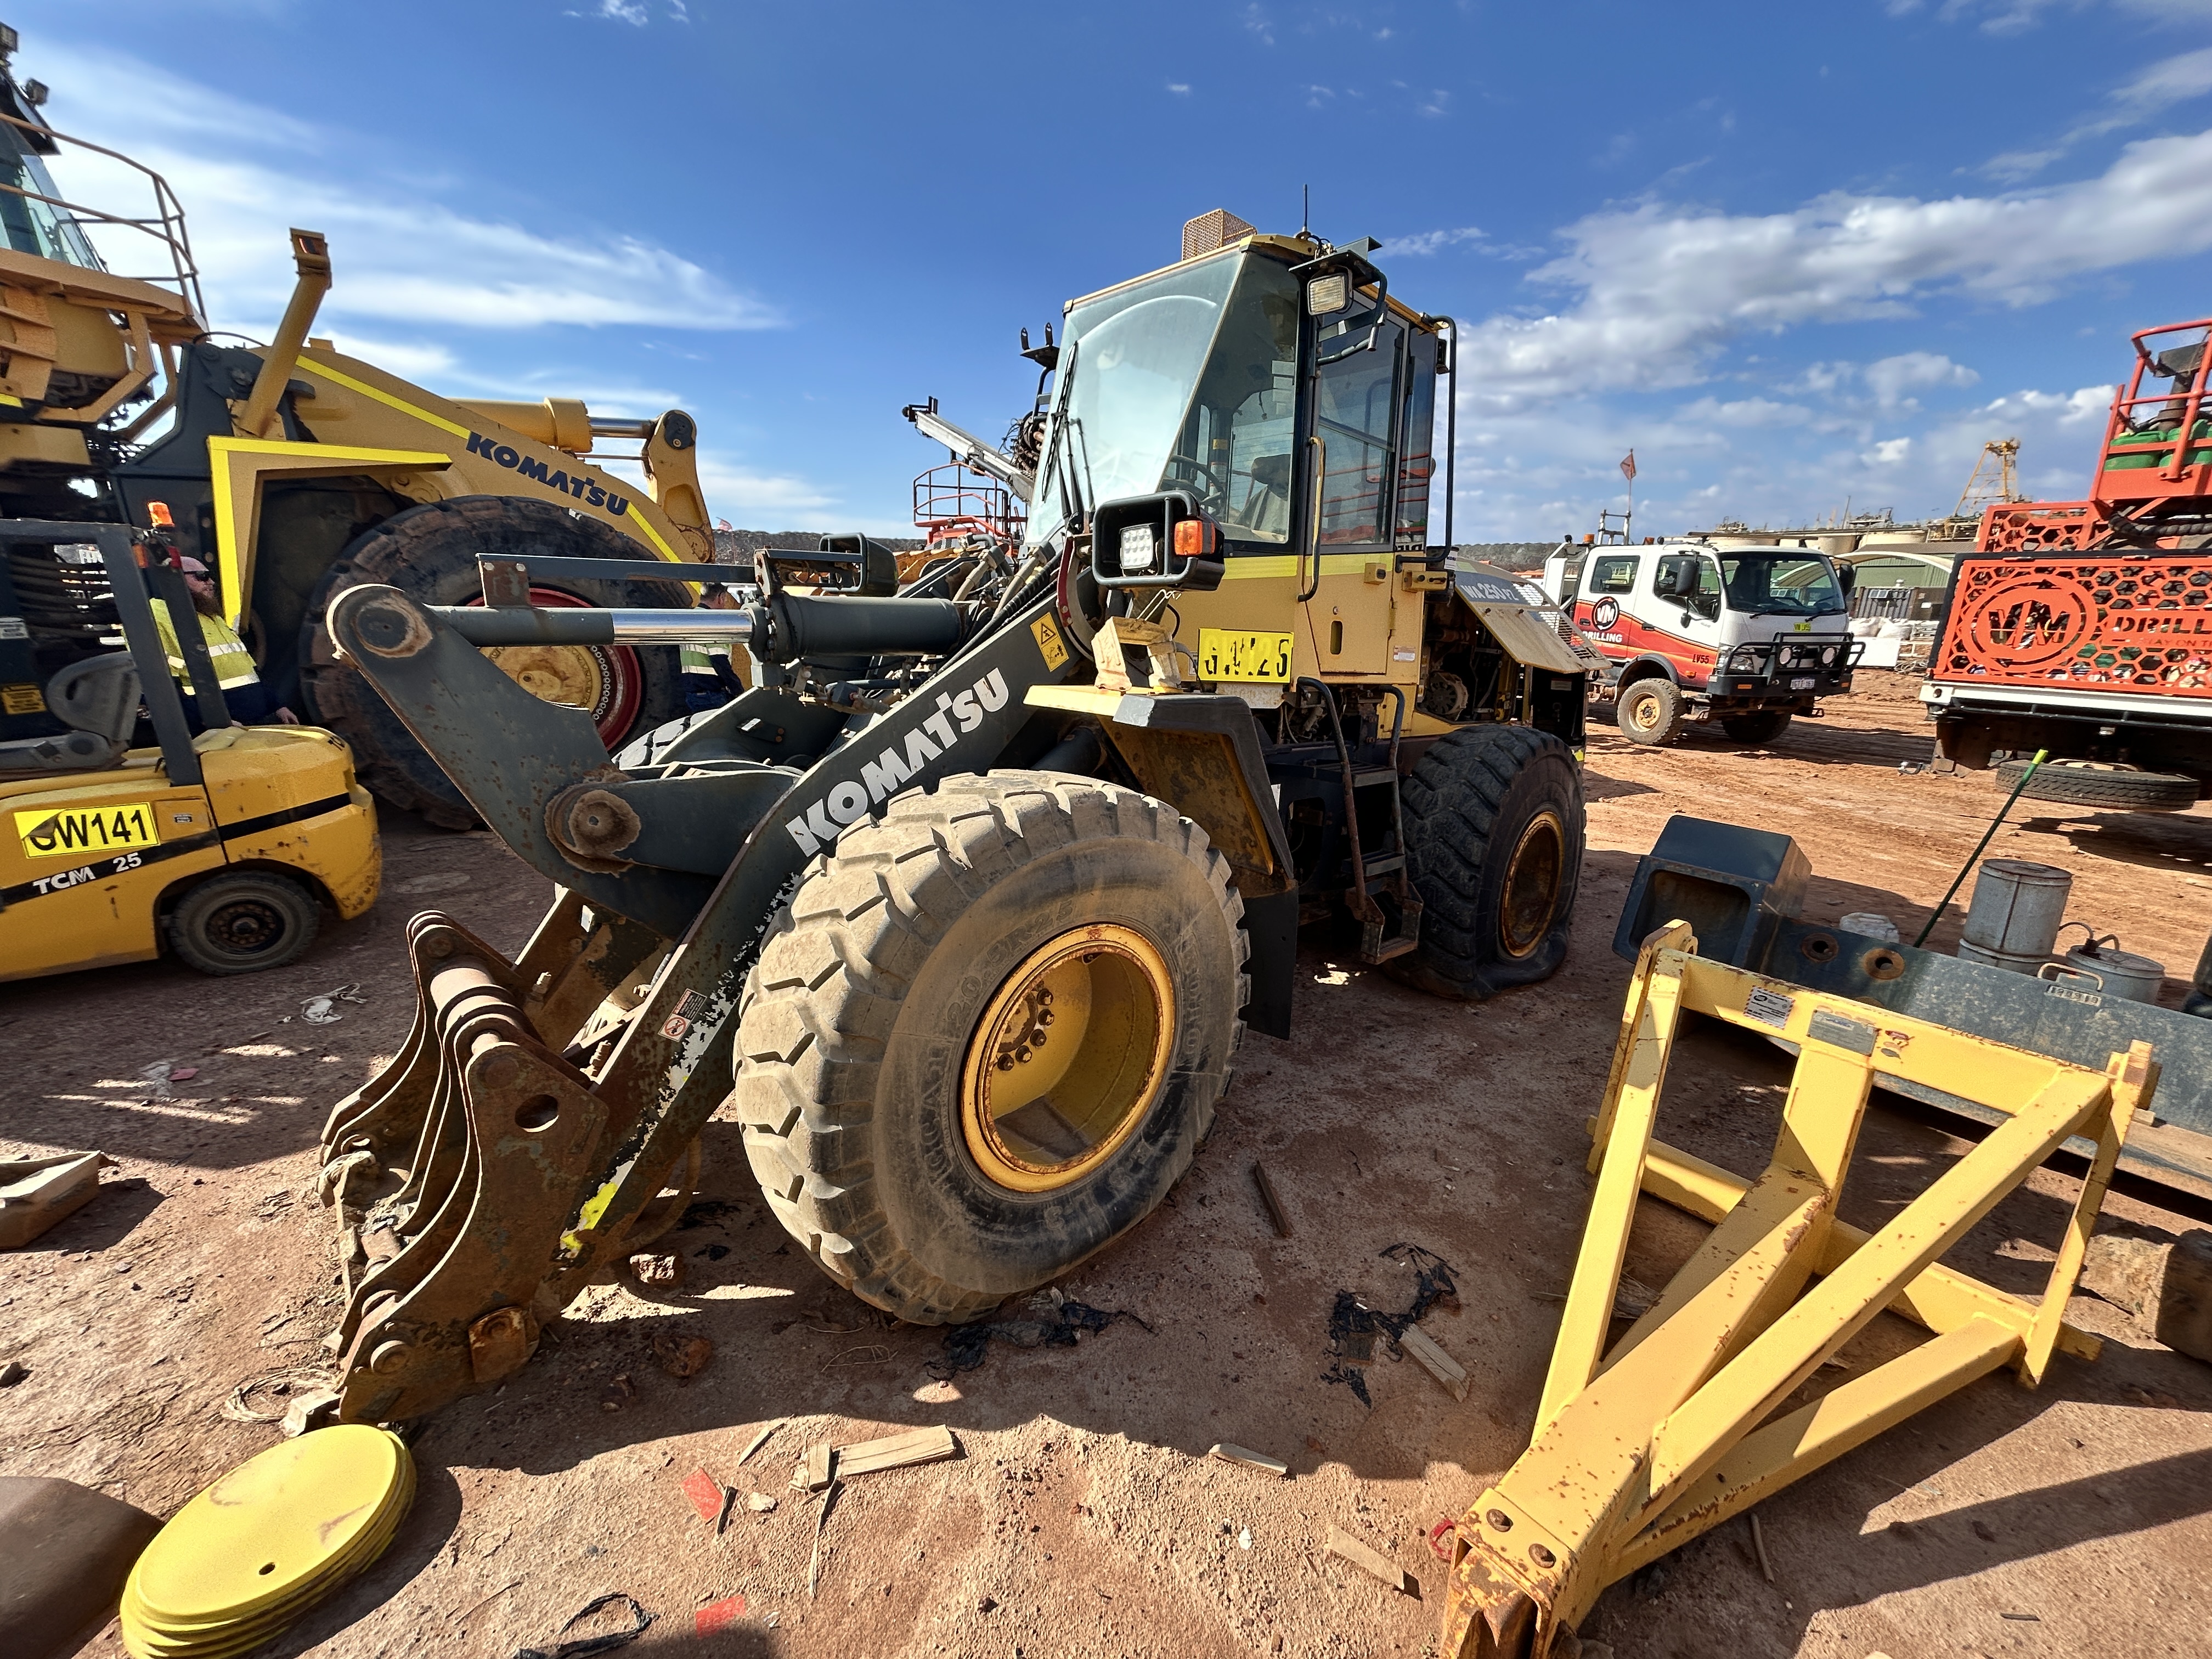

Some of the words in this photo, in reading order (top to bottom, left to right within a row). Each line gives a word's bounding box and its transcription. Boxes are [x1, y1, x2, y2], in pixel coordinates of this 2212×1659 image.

[466, 431, 629, 516] KOMATSU
[1597, 605, 1615, 623] VM
[785, 667, 1009, 857] KOMATSU
[33, 867, 96, 894] TCM
[113, 852, 142, 872] 25
